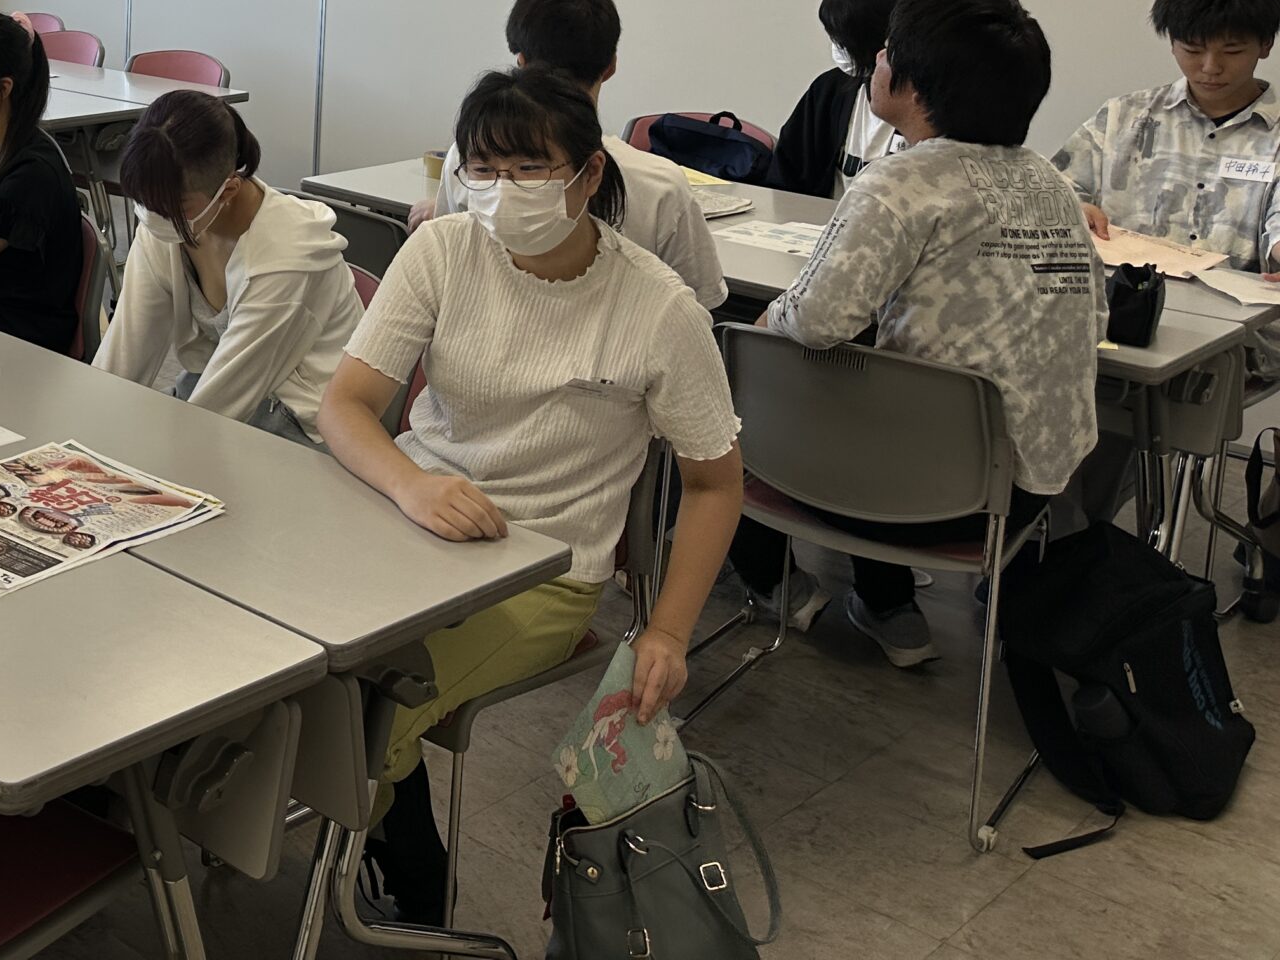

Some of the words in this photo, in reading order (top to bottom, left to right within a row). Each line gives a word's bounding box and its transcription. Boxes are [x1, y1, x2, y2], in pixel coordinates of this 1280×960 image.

[978, 188, 1079, 226] RATION
[1008, 228, 1022, 239] ONE
[1022, 229, 1040, 240] RUNS
[1040, 229, 1050, 239] IN
[1050, 228, 1072, 239] FRONT
